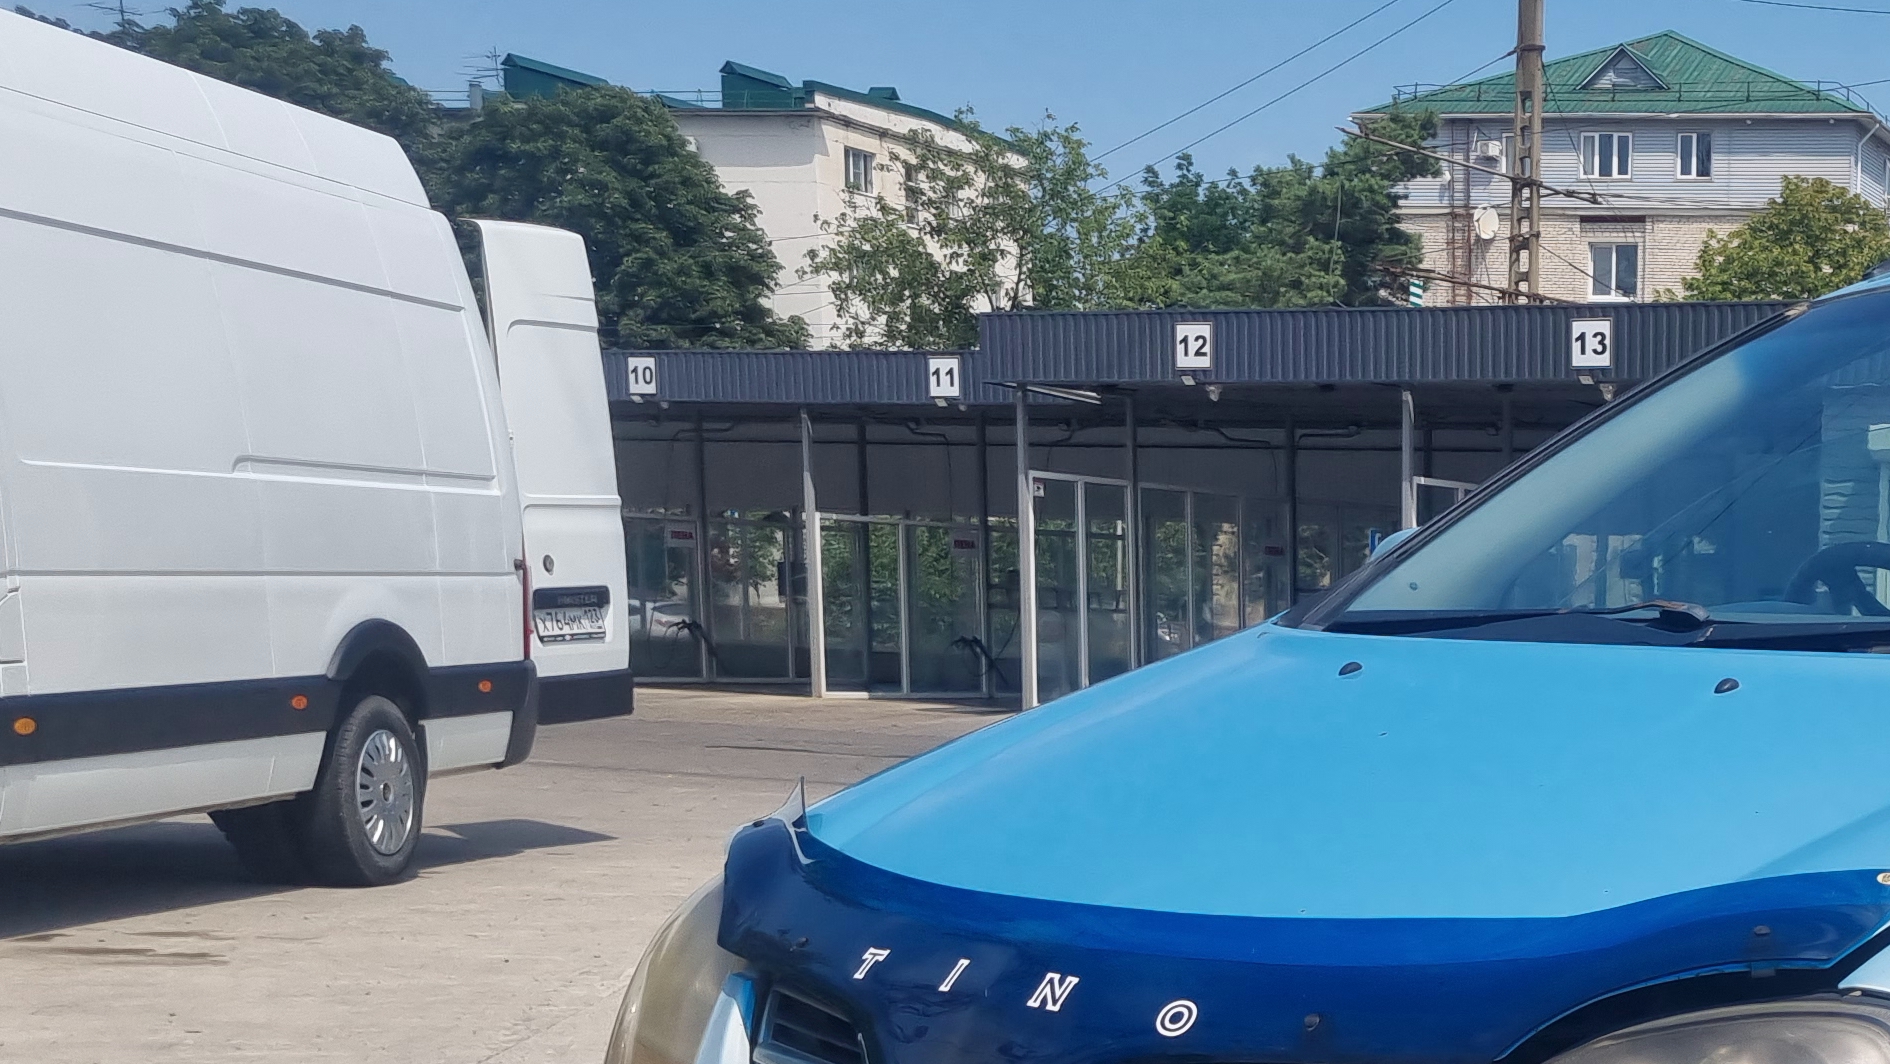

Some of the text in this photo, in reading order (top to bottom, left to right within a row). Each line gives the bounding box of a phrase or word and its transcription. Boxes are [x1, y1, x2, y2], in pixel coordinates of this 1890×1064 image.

[1177, 334, 1209, 358] 12
[1573, 331, 1608, 356] 13
[630, 365, 654, 386] 10
[931, 367, 956, 388] 11
[853, 947, 1198, 1037] TINO
